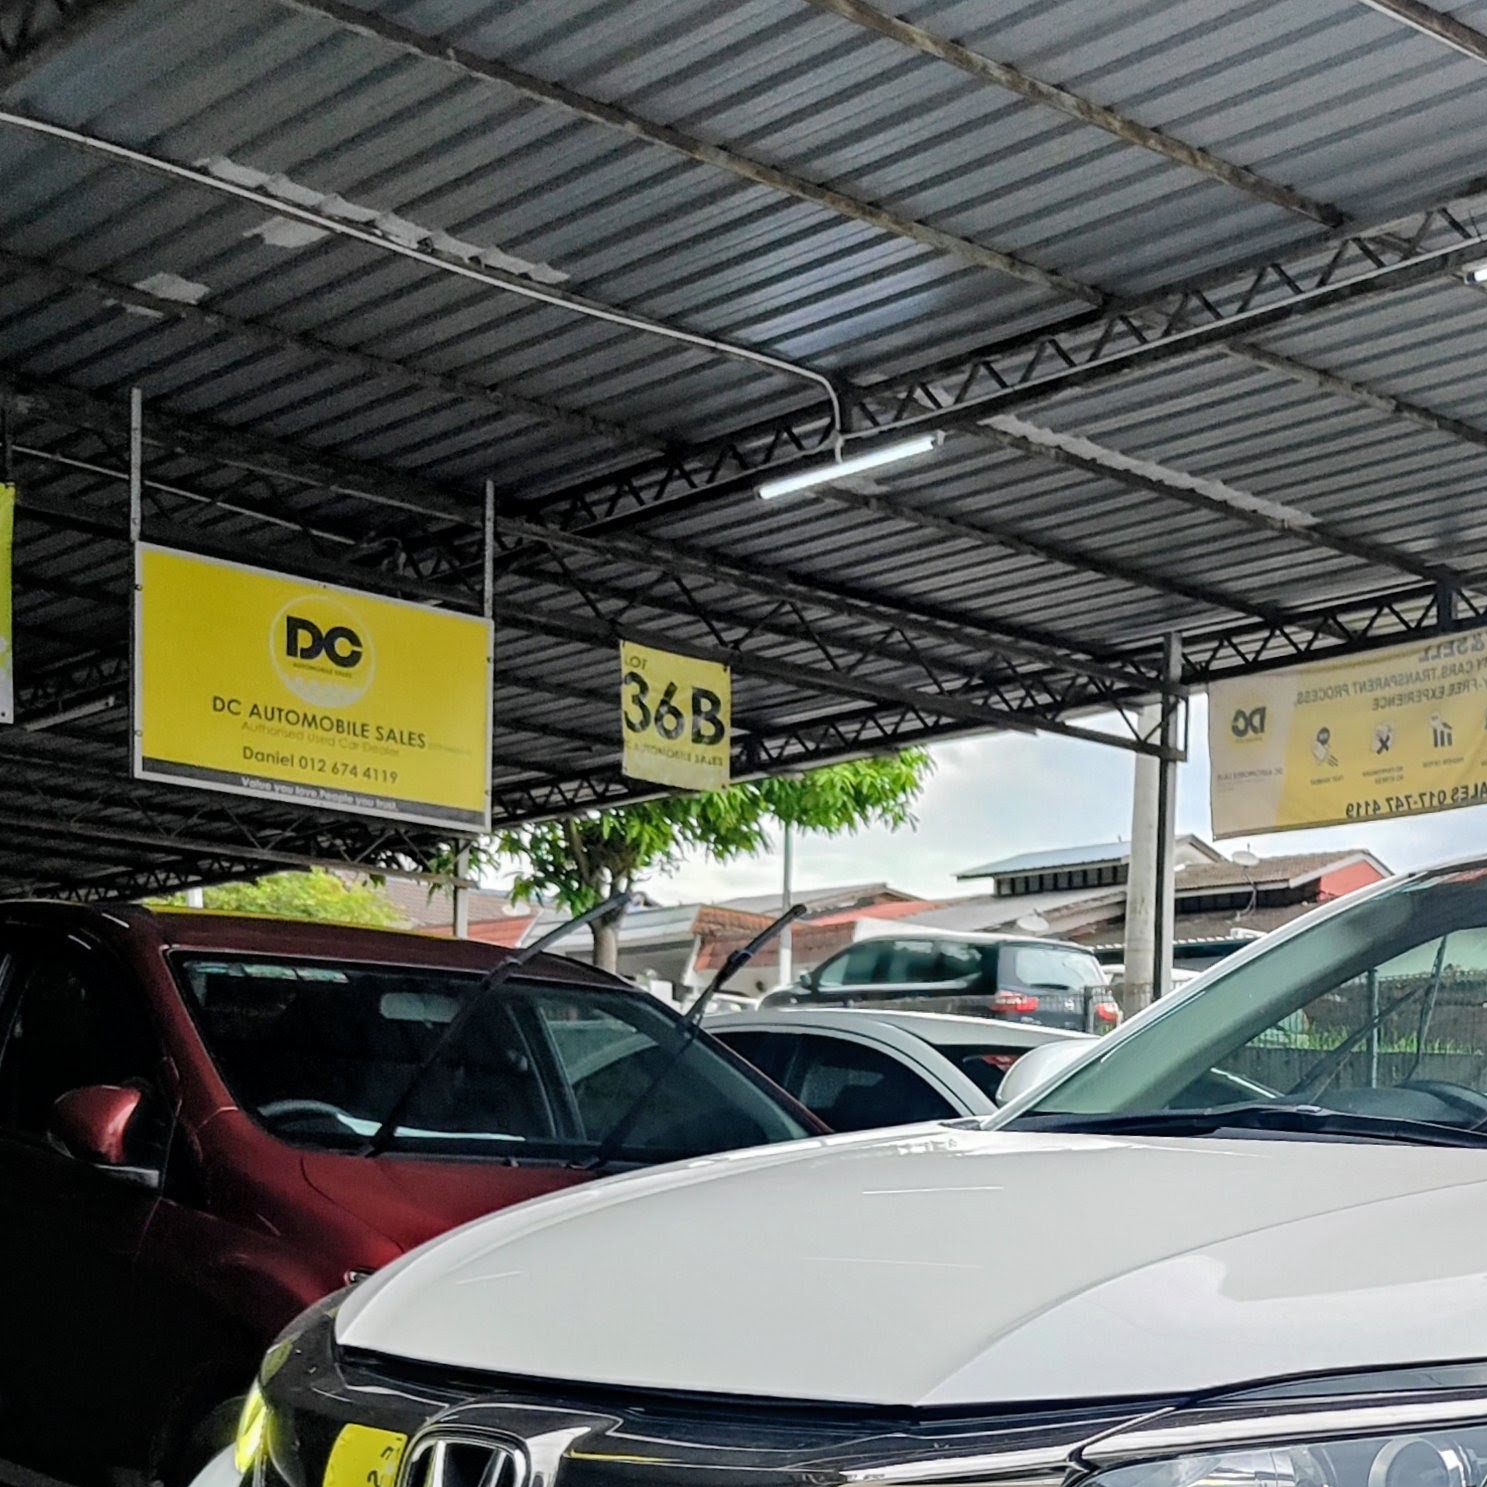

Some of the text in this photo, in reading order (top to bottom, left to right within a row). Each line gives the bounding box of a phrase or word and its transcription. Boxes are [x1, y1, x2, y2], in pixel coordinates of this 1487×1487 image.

[286, 615, 363, 669] DC
[212, 695, 426, 750] DC AUTOMOBILE SALES
[624, 671, 725, 746] 36B
[307, 731, 335, 748] Used
[241, 776, 272, 791] Value
[243, 745, 398, 785] Daniel 012 674 4119
